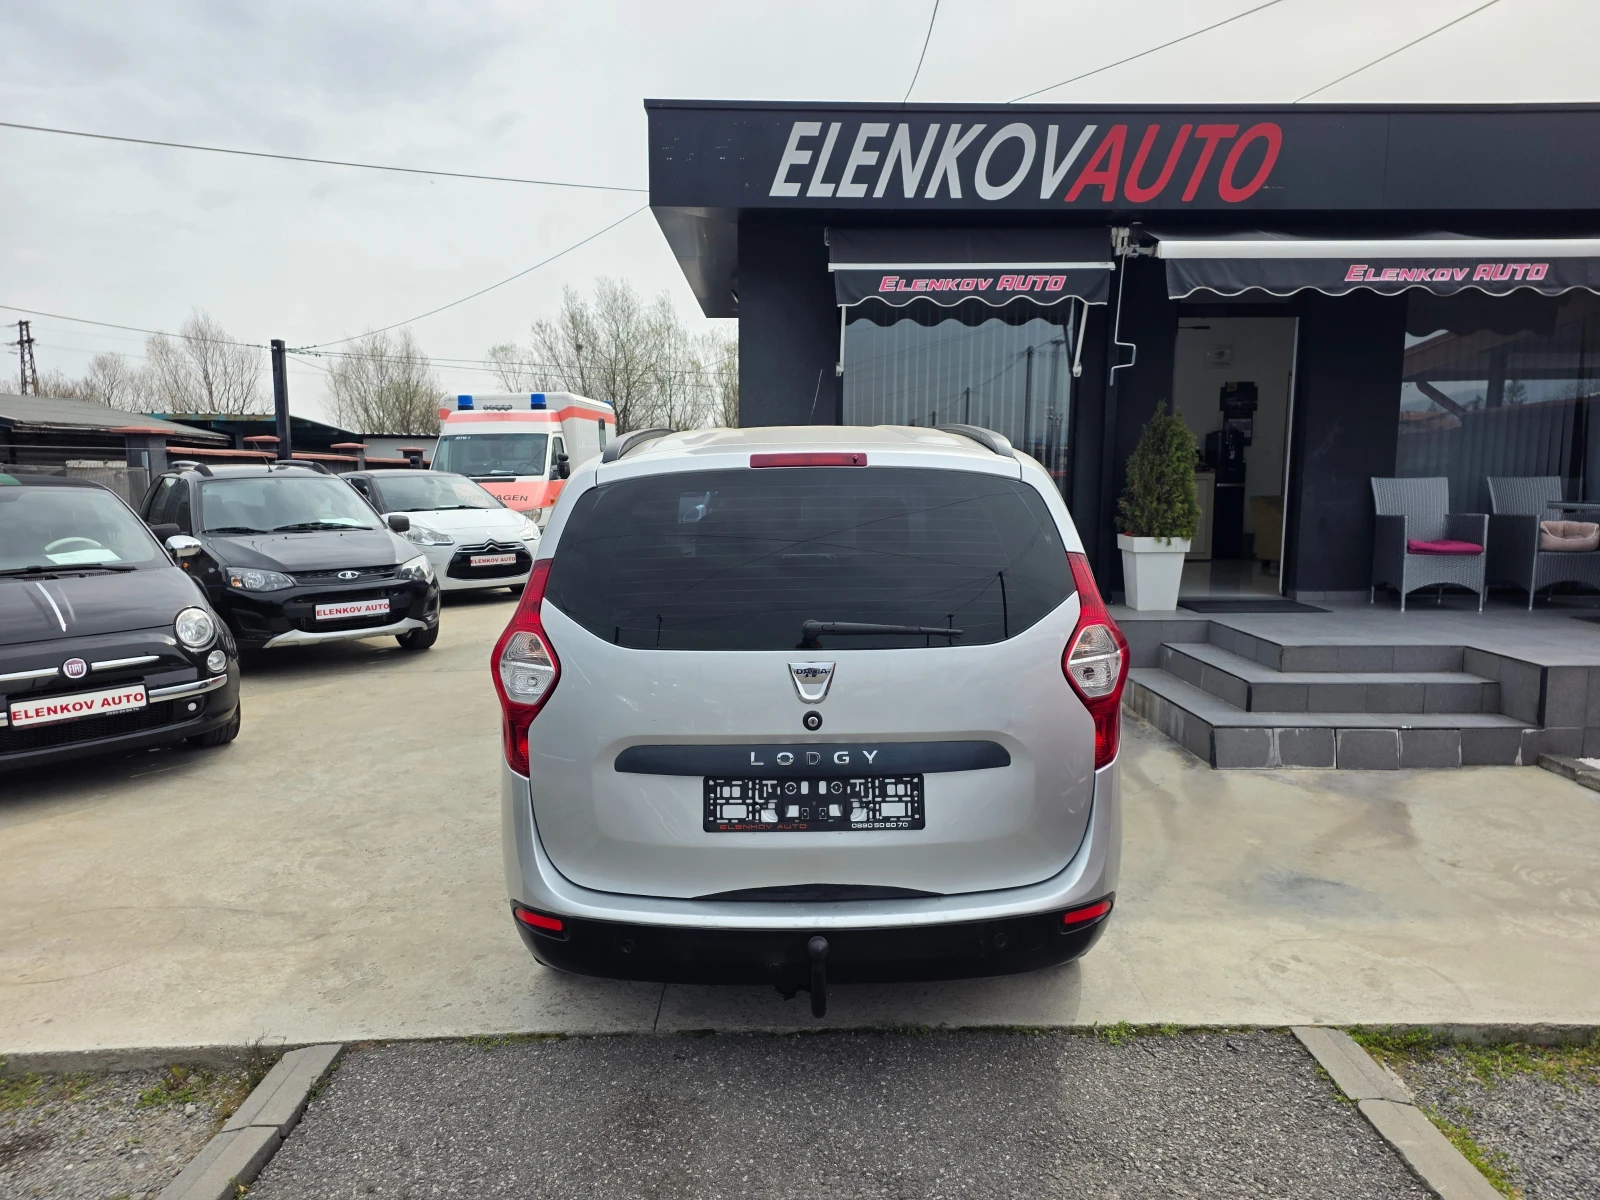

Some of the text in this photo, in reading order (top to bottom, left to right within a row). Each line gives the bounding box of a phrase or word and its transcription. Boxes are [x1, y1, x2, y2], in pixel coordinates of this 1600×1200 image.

[1472, 263, 1550, 281] AUTO
[996, 275, 1067, 291] AUTO
[470, 557, 499, 565] ELENKOV
[316, 606, 362, 617] ELENKOV
[365, 603, 390, 612] AUTO
[68, 663, 82, 674] FIAT
[11, 700, 95, 721] ELENKOV
[101, 692, 144, 708] AUTO
[750, 750, 878, 766] LODGY
